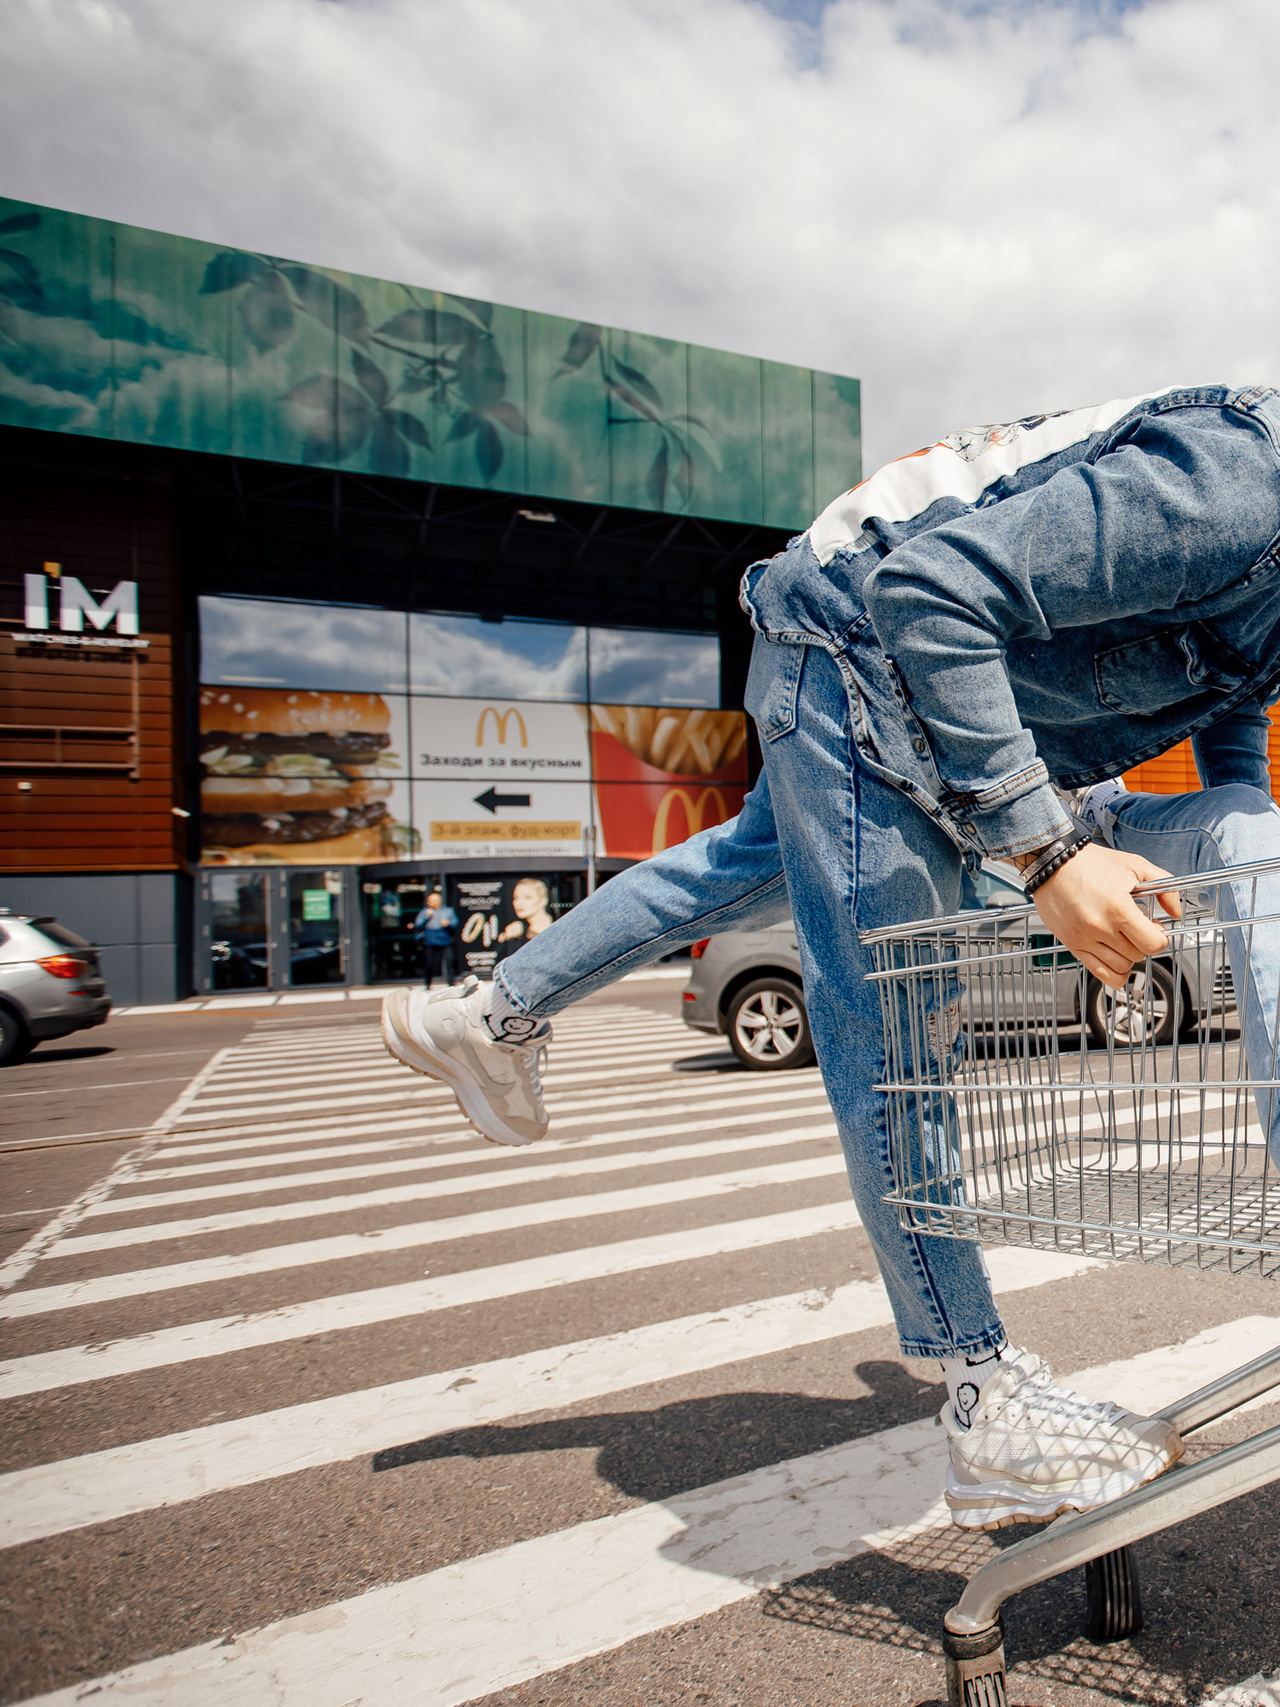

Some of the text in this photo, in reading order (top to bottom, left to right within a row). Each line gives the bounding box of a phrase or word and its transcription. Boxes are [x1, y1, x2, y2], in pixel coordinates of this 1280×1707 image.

[420, 753, 582, 771] Заходи за вкусным
